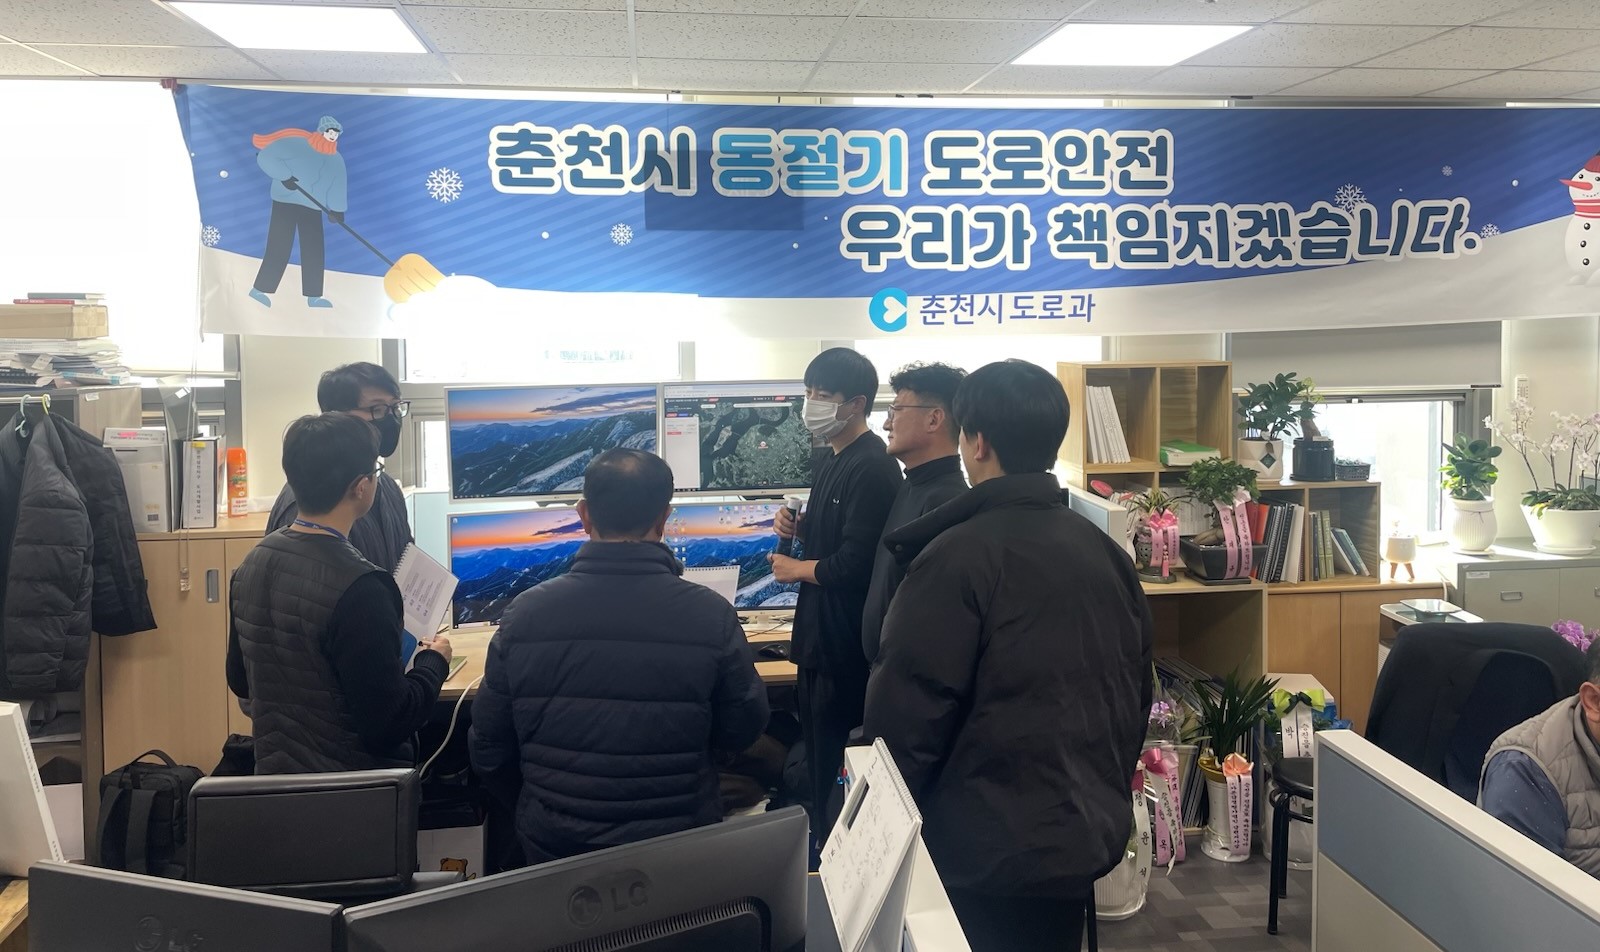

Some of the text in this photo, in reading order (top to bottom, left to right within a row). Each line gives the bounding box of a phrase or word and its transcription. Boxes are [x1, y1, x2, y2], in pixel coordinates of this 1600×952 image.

[489, 123, 1175, 198] 춘천시 동절기 도로안전
[840, 197, 1482, 273] 우리가 책임지겠습니다.
